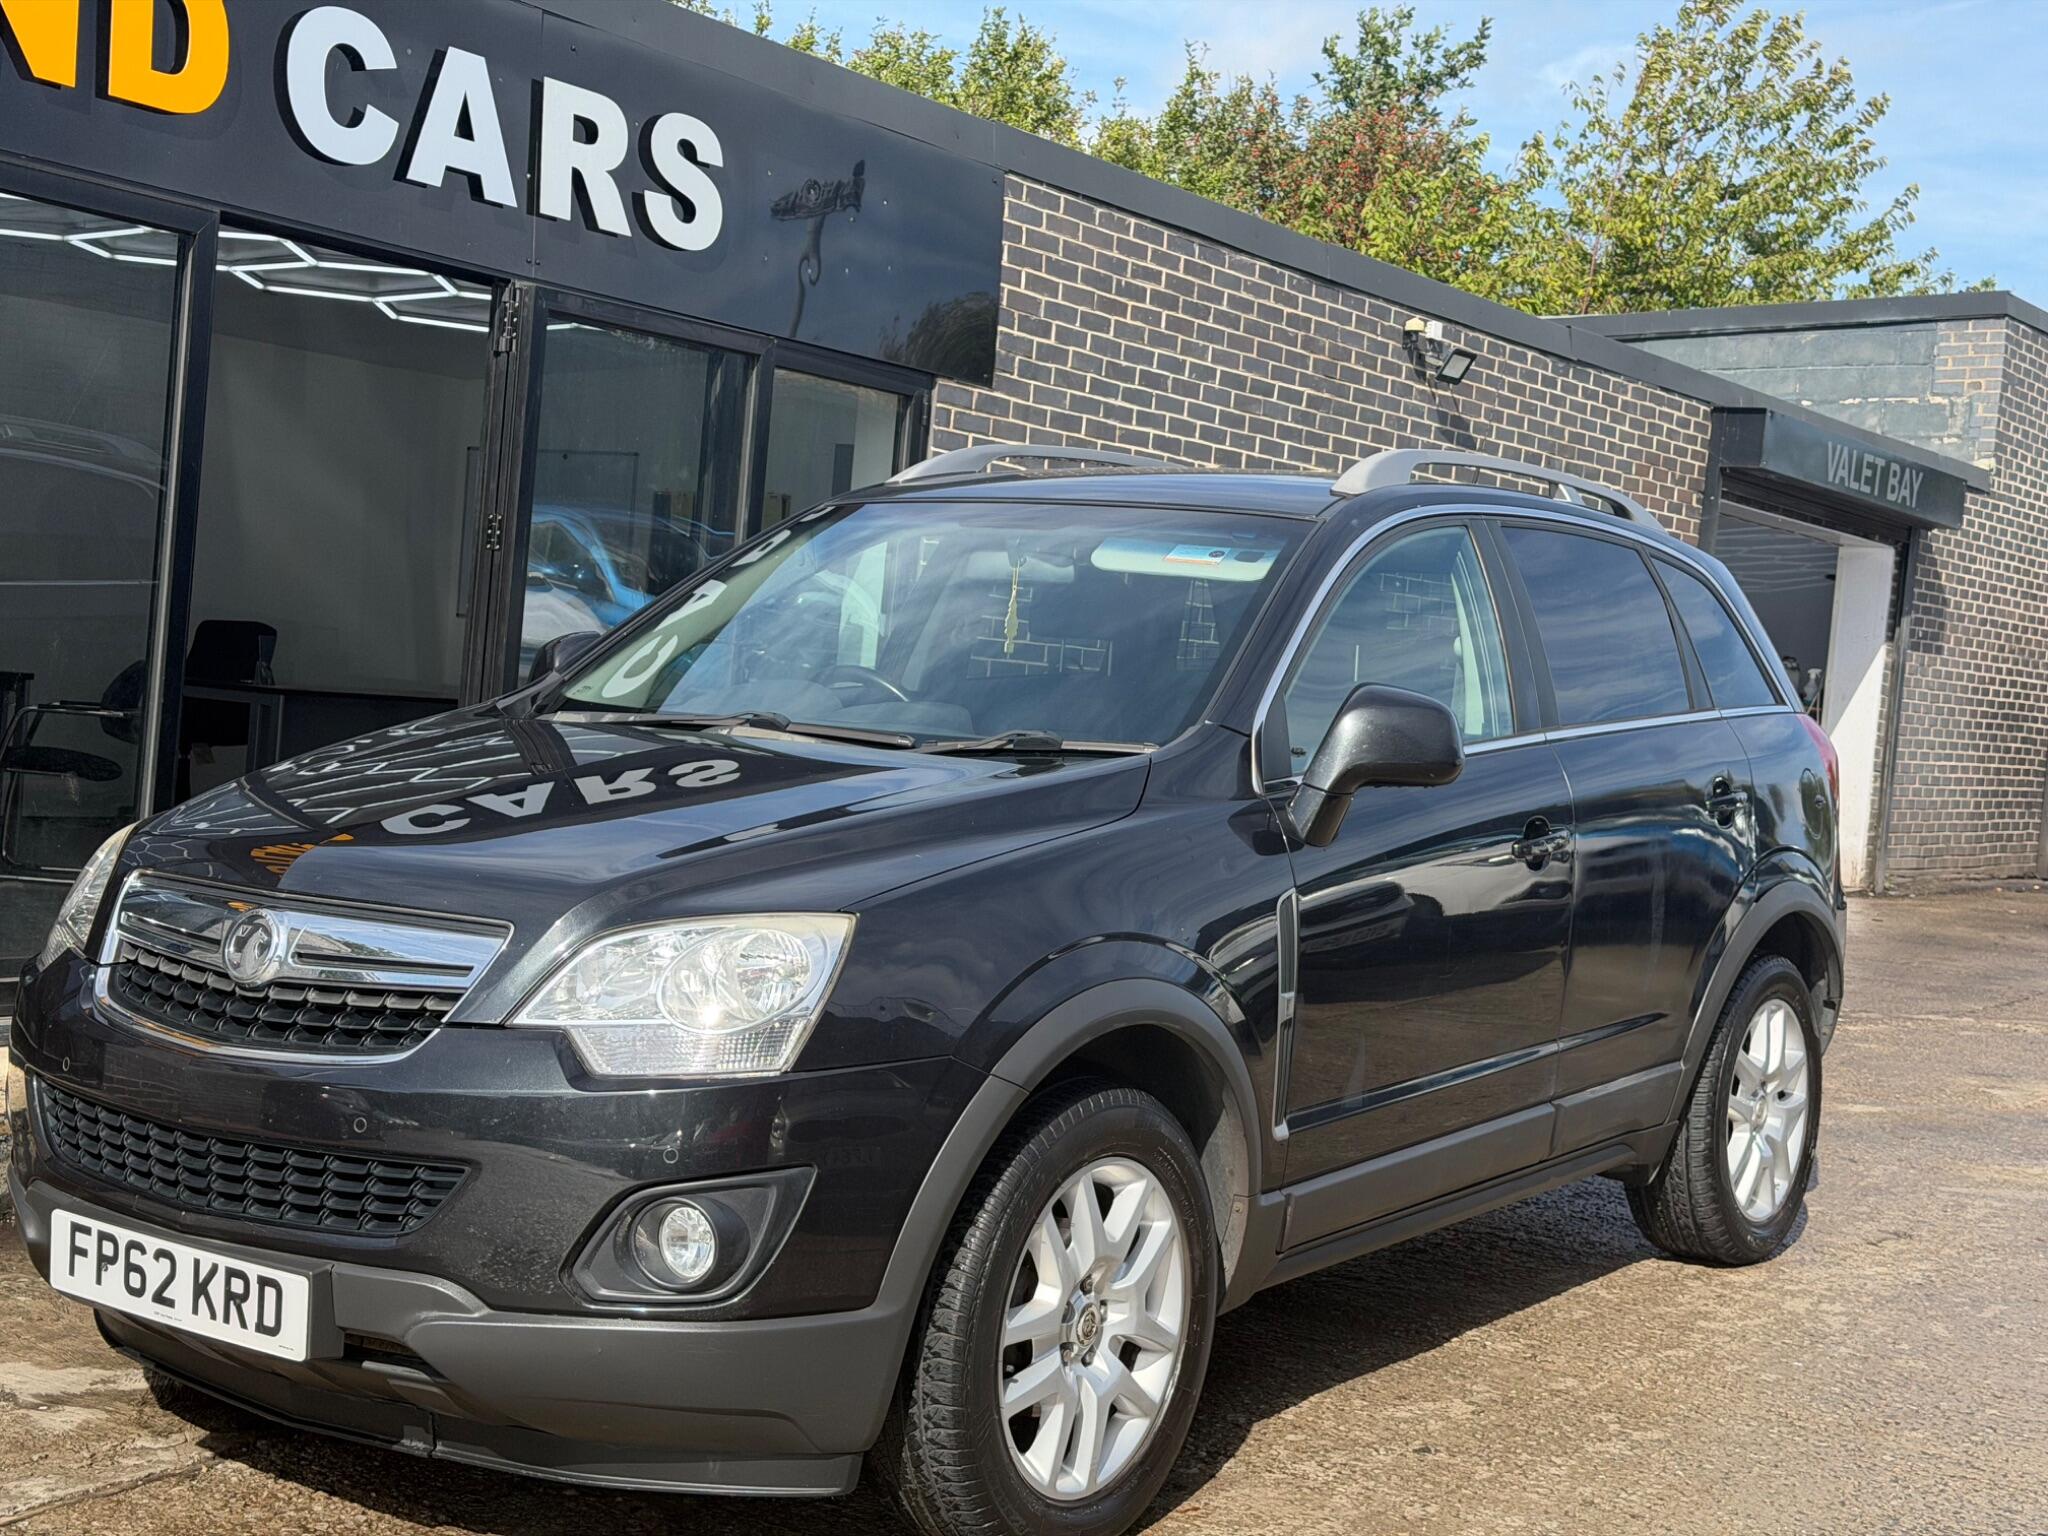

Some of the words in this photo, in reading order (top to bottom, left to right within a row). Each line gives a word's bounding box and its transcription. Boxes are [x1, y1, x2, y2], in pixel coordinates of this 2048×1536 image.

[287, 6, 724, 251] CARS
[1827, 441, 1886, 497] VALET
[1886, 462, 1924, 508] BAY
[68, 1221, 178, 1309] FP62
[192, 1257, 283, 1338] KRD
